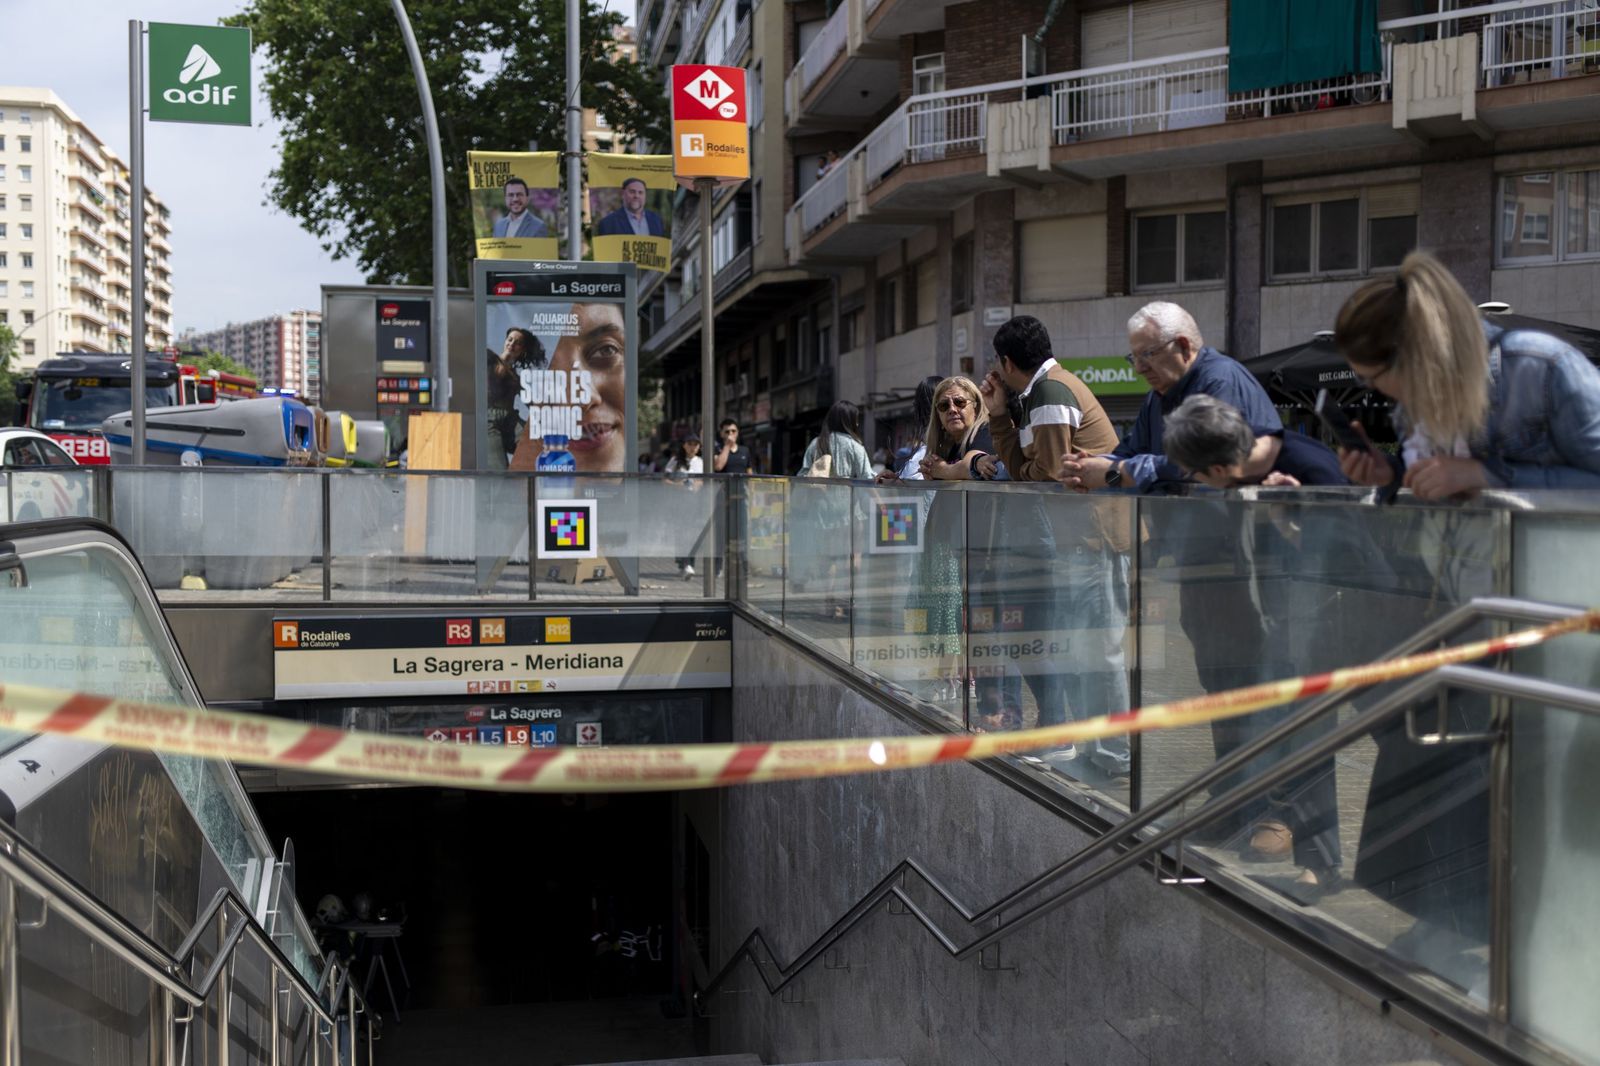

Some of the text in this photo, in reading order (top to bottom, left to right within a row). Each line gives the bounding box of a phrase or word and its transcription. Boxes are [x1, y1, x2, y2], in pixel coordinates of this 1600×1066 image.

[163, 83, 238, 106] adif
[699, 80, 720, 99] M
[690, 137, 704, 152] R
[706, 142, 745, 154] Rodalies
[473, 161, 511, 174] AL COSTAT
[474, 173, 516, 188] DE LA GEN
[622, 240, 658, 256] AL COSTAT
[541, 262, 555, 270] Clear
[550, 280, 622, 296] La Sagrera
[392, 319, 421, 328] Sagrera
[532, 312, 579, 325] AQUARIUS
[519, 360, 592, 404] SUAR ÉS
[529, 405, 583, 440] BONIC
[281, 625, 297, 641] R
[301, 631, 351, 642] Rodalies
[448, 624, 472, 639] R3
[481, 623, 504, 638] R4
[546, 622, 570, 636] R12
[695, 626, 727, 639] renfe
[310, 640, 340, 648] Catalunya
[392, 657, 417, 674] La
[424, 656, 504, 676] Sagrera
[525, 653, 624, 671] Meridiana
[490, 706, 562, 721] La Sagrera
[433, 734, 442, 742] M
[455, 731, 473, 746] L1
[480, 731, 501, 746] L5
[507, 730, 528, 744] L9
[532, 730, 555, 743] L10
